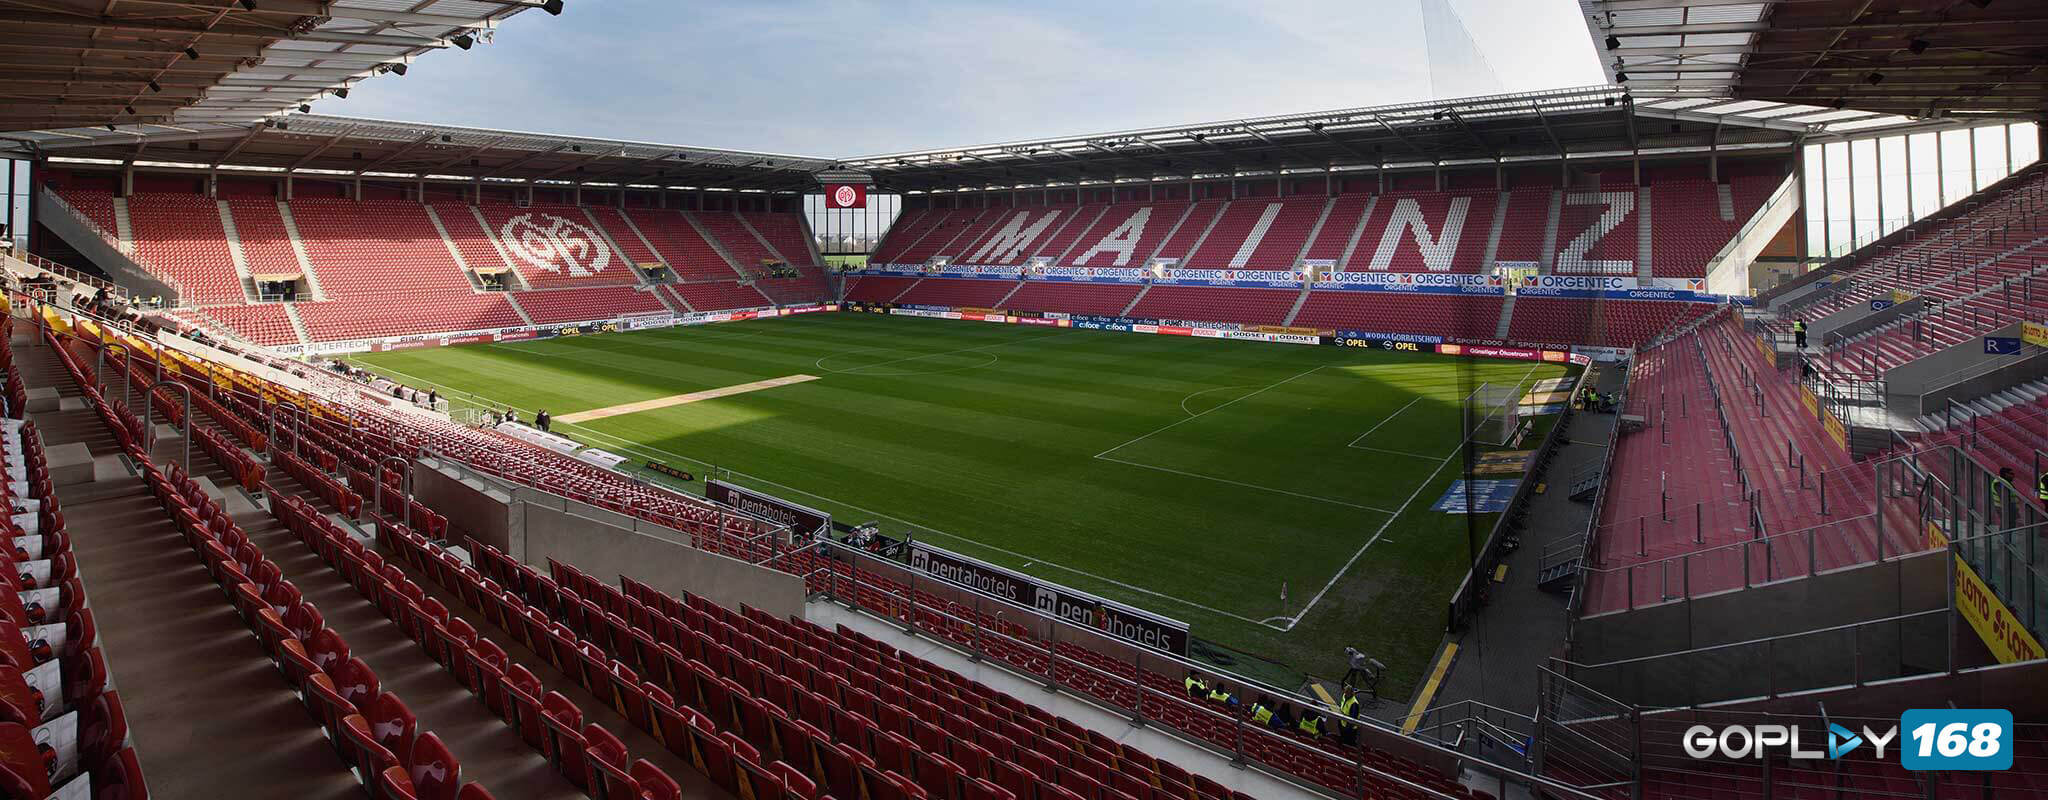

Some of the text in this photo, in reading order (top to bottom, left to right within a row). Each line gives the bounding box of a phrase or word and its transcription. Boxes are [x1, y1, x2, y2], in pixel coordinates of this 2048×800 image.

[966, 192, 1634, 273] MAINZ
[943, 265, 976, 273] ORGENTEC
[1046, 267, 1085, 275] ORGENTEC
[1096, 268, 1139, 277] ORGENTEC
[1174, 269, 1222, 279] ORGENTEC
[1237, 270, 1290, 281] ORGENTEC
[1334, 272, 1396, 283] ORGENTEC
[1415, 274, 1484, 285] ORGENTEC
[1384, 283, 1418, 291] ORGENTEC
[1542, 276, 1623, 288] ORGENTEC
[1461, 286, 1499, 294] ORGENTEC
[1520, 287, 1561, 295] ORGENTEC
[1629, 290, 1675, 299] ORGENTEC
[1364, 331, 1391, 340] WODKA
[1346, 338, 1368, 348] OPEL
[1395, 341, 1419, 351] OPEL
[1456, 337, 1480, 345] SPORT
[1987, 339, 2000, 352] R
[741, 497, 799, 528] pentahotels
[931, 559, 1017, 600] pentahotels
[1962, 573, 1990, 622] LOTTO
[1061, 600, 1170, 651] penahotels
